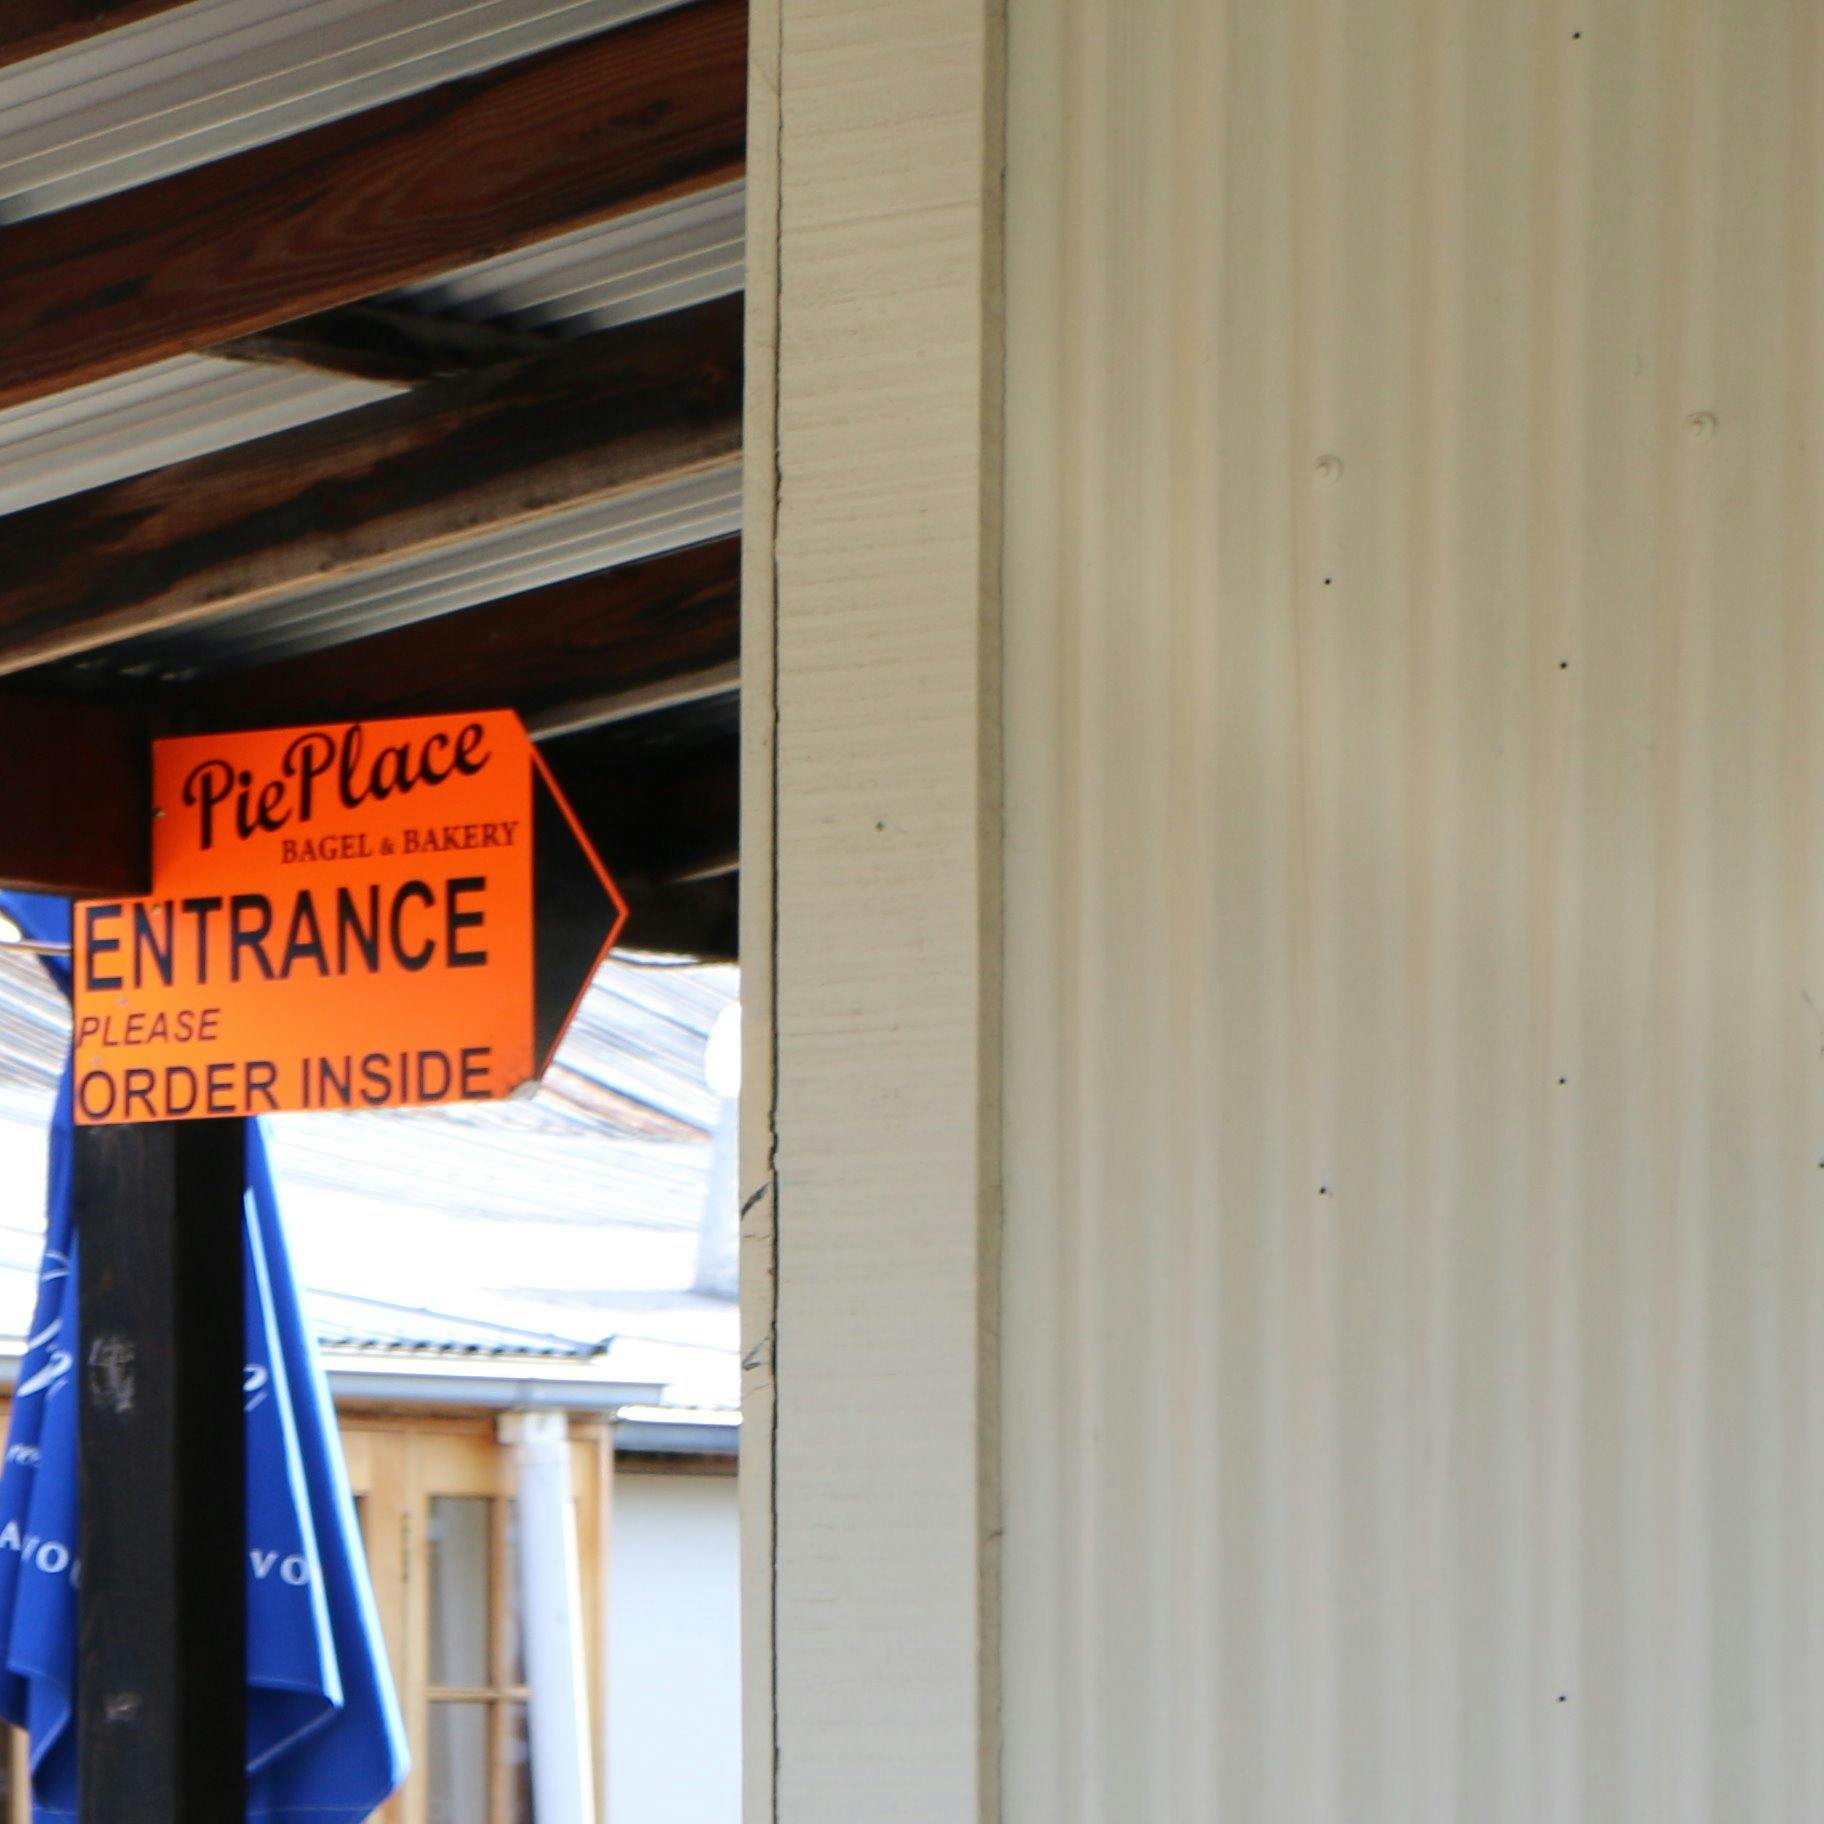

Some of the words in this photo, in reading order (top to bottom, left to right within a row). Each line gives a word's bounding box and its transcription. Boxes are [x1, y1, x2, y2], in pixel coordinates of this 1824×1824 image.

[280, 834, 372, 865] BAGEL
[379, 836, 397, 856] &
[403, 821, 520, 854] BAKERY
[85, 876, 488, 991] ENTRANCE
[77, 1008, 221, 1049] PLEASE
[79, 1060, 279, 1119] ORDER
[302, 1047, 492, 1108] INSIDE
